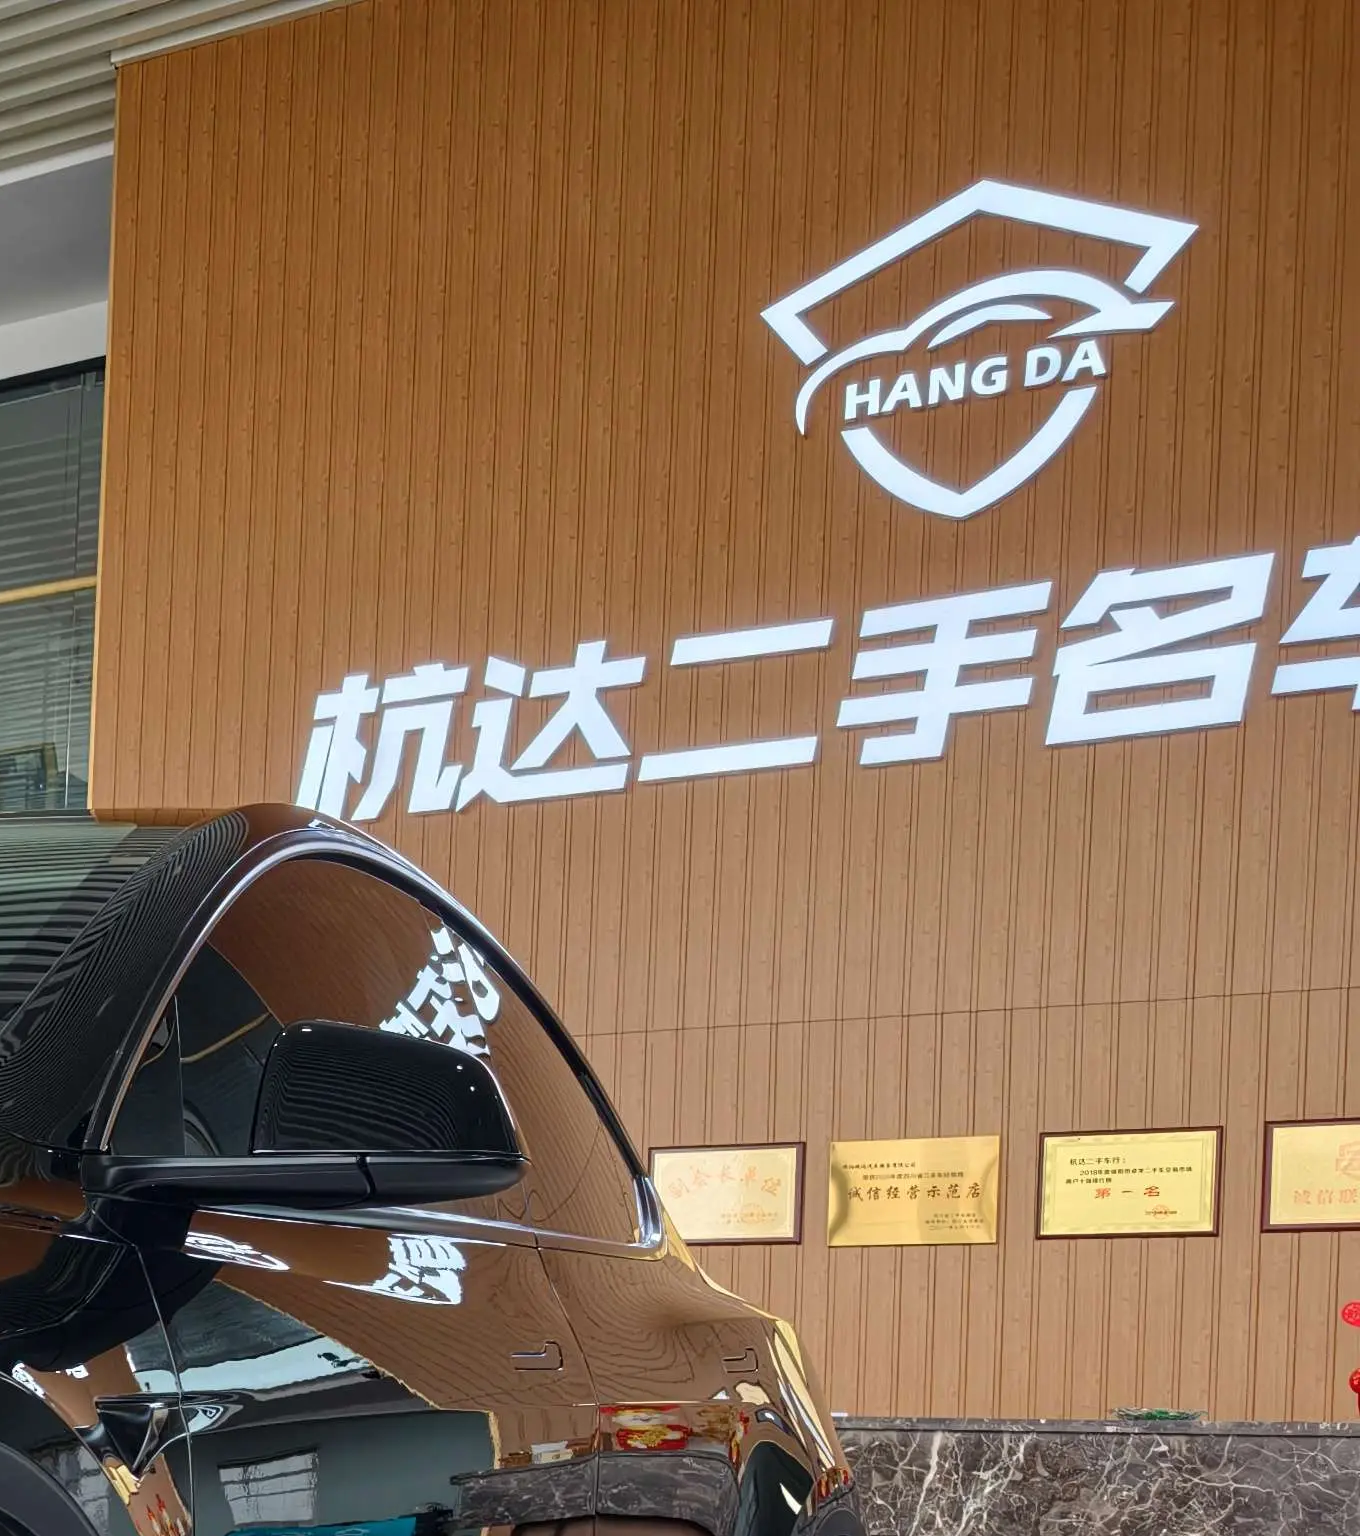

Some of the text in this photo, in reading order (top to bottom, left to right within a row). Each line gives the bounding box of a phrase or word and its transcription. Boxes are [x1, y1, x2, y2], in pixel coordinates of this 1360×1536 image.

[843, 338, 1107, 420] HANG DA
[848, 1181, 982, 1202] 诚信经营示范店
[1094, 1185, 1160, 1199] 第一名
